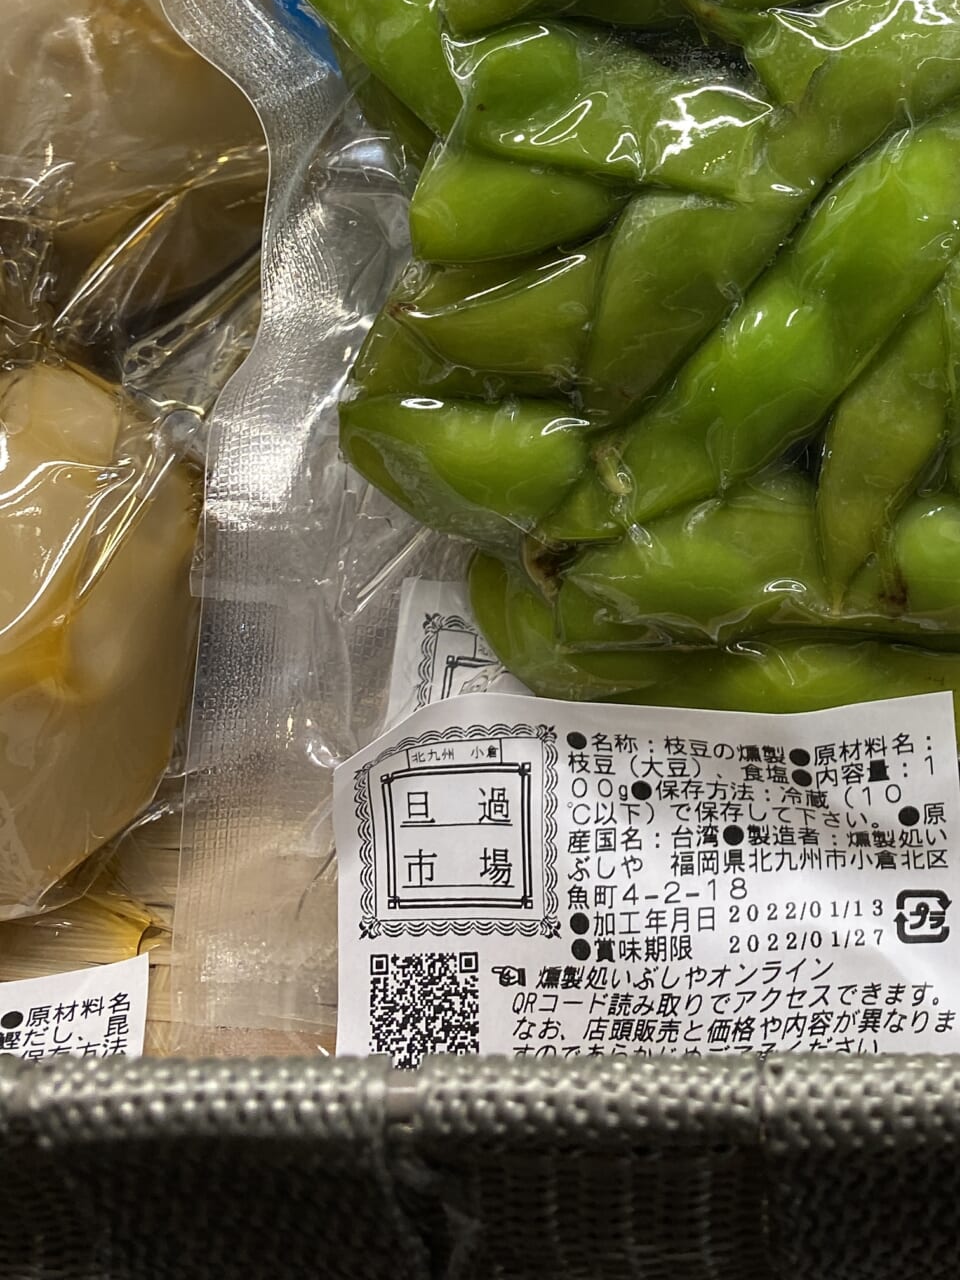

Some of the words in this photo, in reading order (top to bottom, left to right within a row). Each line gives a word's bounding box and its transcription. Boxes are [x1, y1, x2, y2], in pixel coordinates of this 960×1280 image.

[411, 748, 455, 764] 北九州
[470, 745, 499, 759] 小倉
[568, 855, 643, 882] ぶしや
[670, 848, 949, 877] 福岡県北九州市小倉北区
[729, 898, 884, 924] 2022/01/13
[729, 928, 884, 955] 2022/01/27
[512, 981, 940, 1017] QRコード読み取りでアクセスできます。
[512, 1008, 957, 1044] なお、店頭販売と価格や内容が異なりま
